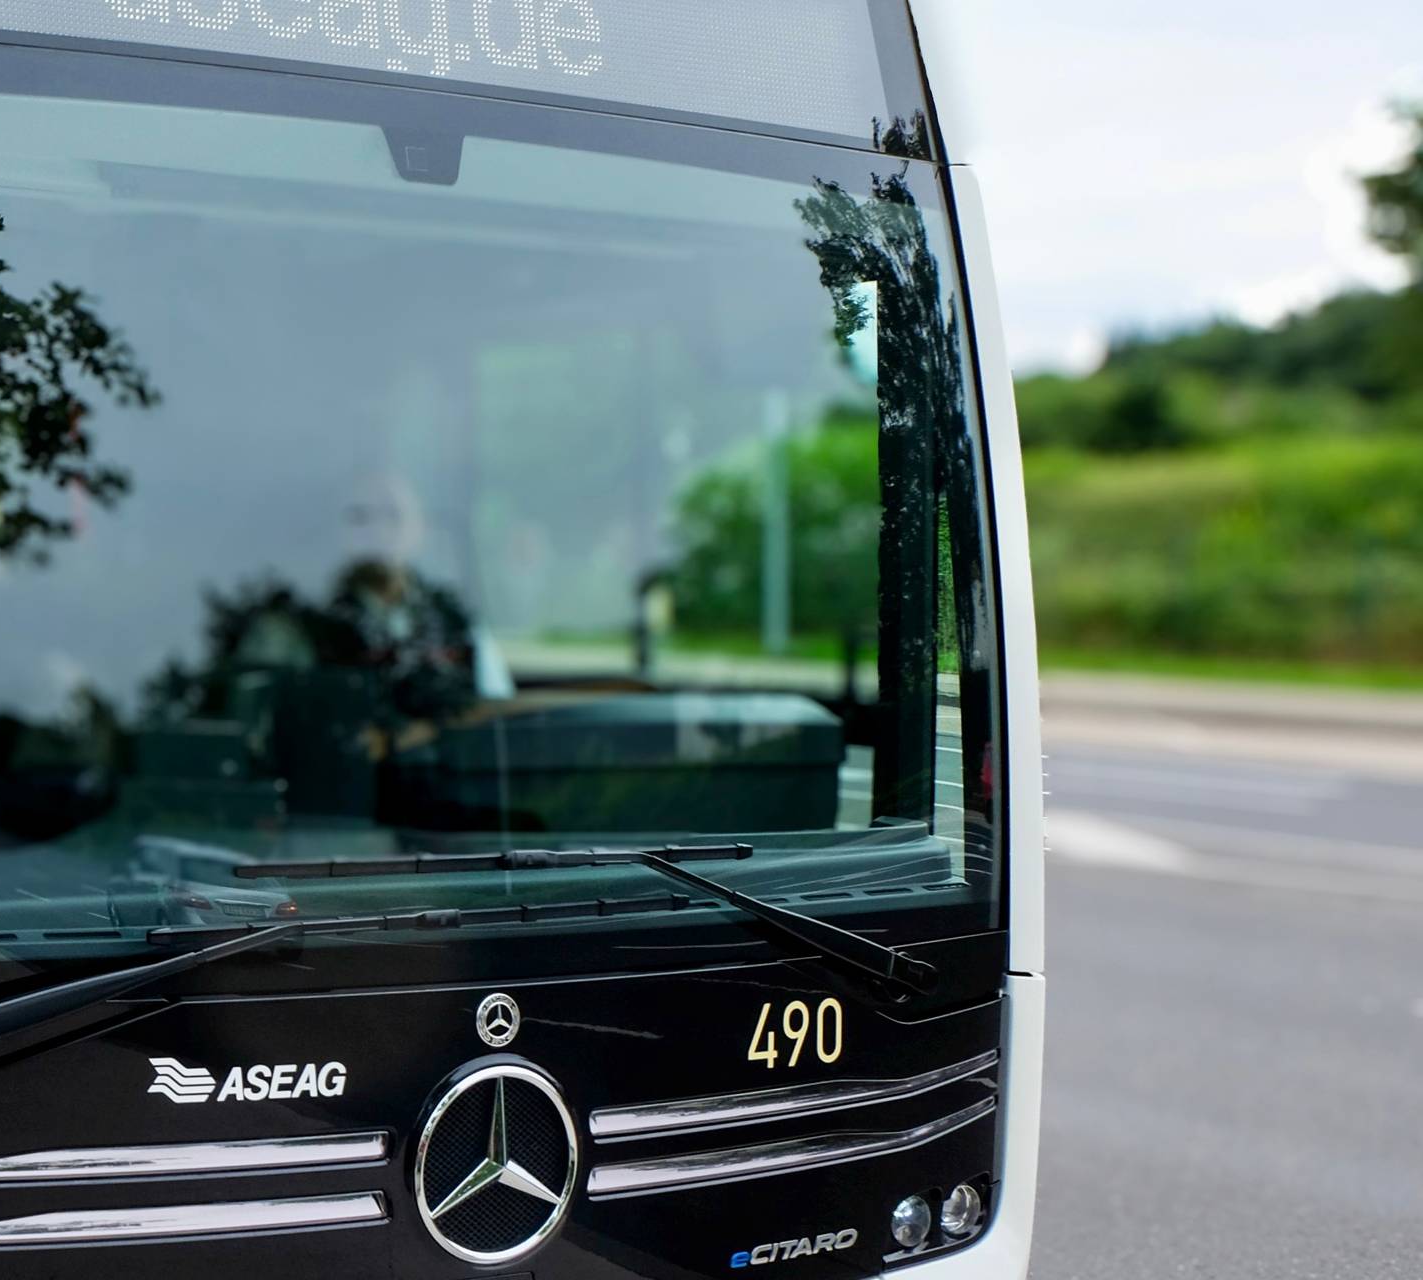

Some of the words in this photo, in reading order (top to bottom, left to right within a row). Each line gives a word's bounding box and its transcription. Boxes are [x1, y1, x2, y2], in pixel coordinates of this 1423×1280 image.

[104, 0, 603, 76] ag.de
[748, 997, 842, 1068] 490
[216, 1061, 347, 1102] ASEAG
[730, 1228, 858, 1268] eCITARO
